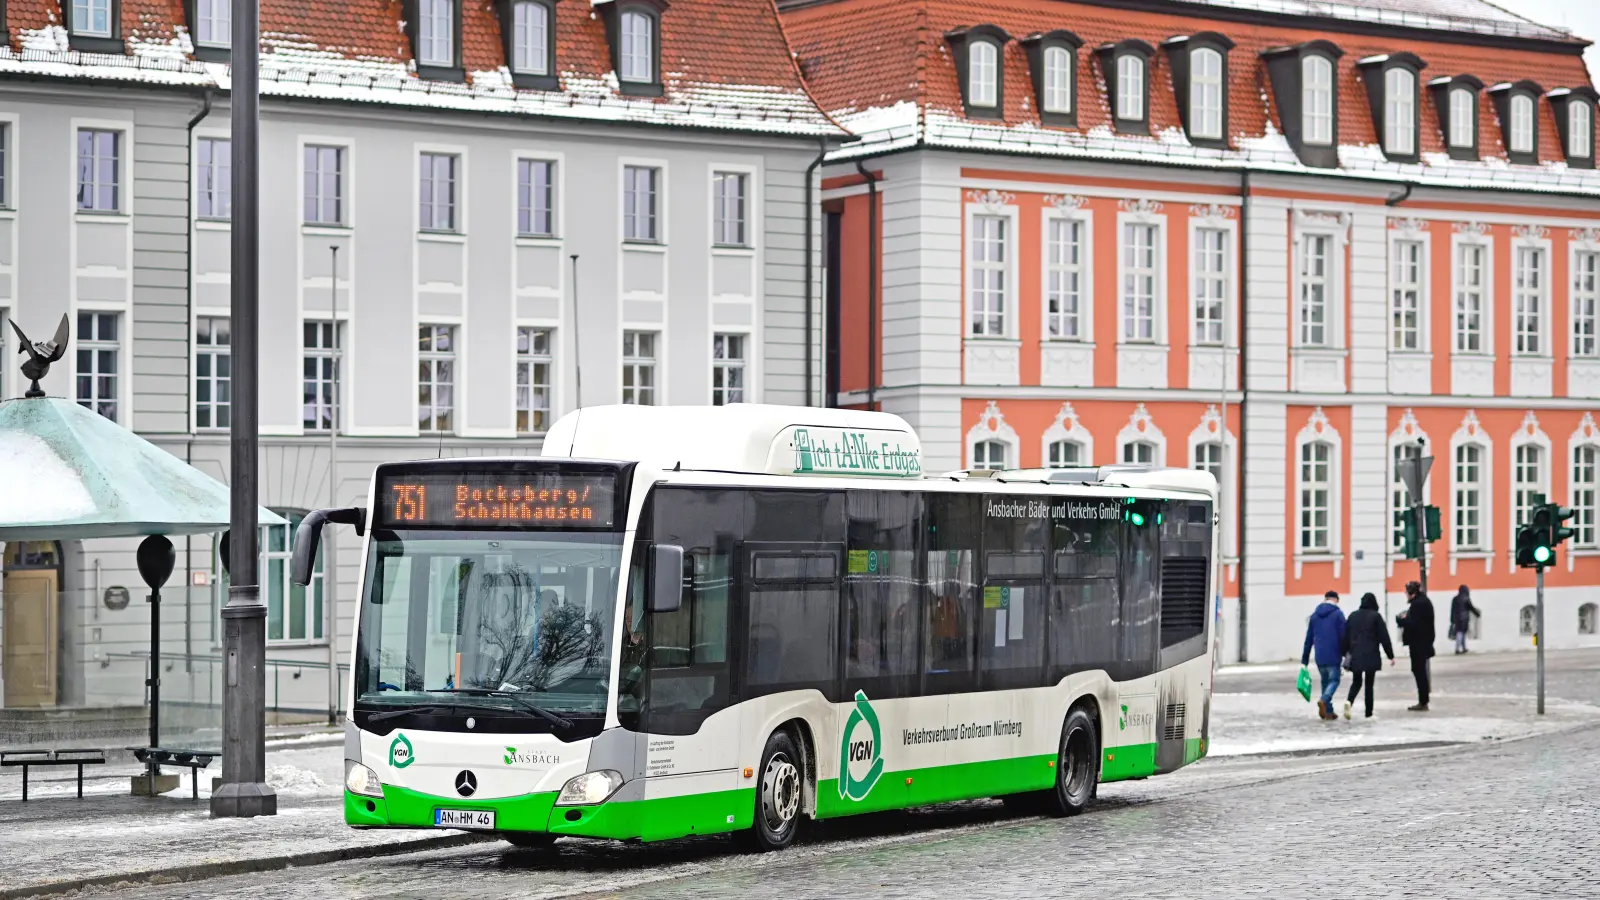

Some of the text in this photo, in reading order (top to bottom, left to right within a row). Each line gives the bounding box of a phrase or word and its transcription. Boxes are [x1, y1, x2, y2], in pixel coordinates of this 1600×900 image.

[811, 438, 832, 468] Ich
[834, 431, 880, 469] tANke
[391, 484, 425, 520] 751
[456, 485, 590, 503] Bocksberg/
[454, 502, 593, 520] Schalkhausen
[987, 499, 1121, 520] Ansbacher Bäder und Verkehrs GmbH
[902, 719, 1023, 746] Verkehrsverbund Großraum Nürnberg
[394, 749, 408, 757] VGN
[510, 752, 560, 764] ANSBACH
[849, 740, 873, 762] VGN
[441, 811, 490, 825] AN HM 46
